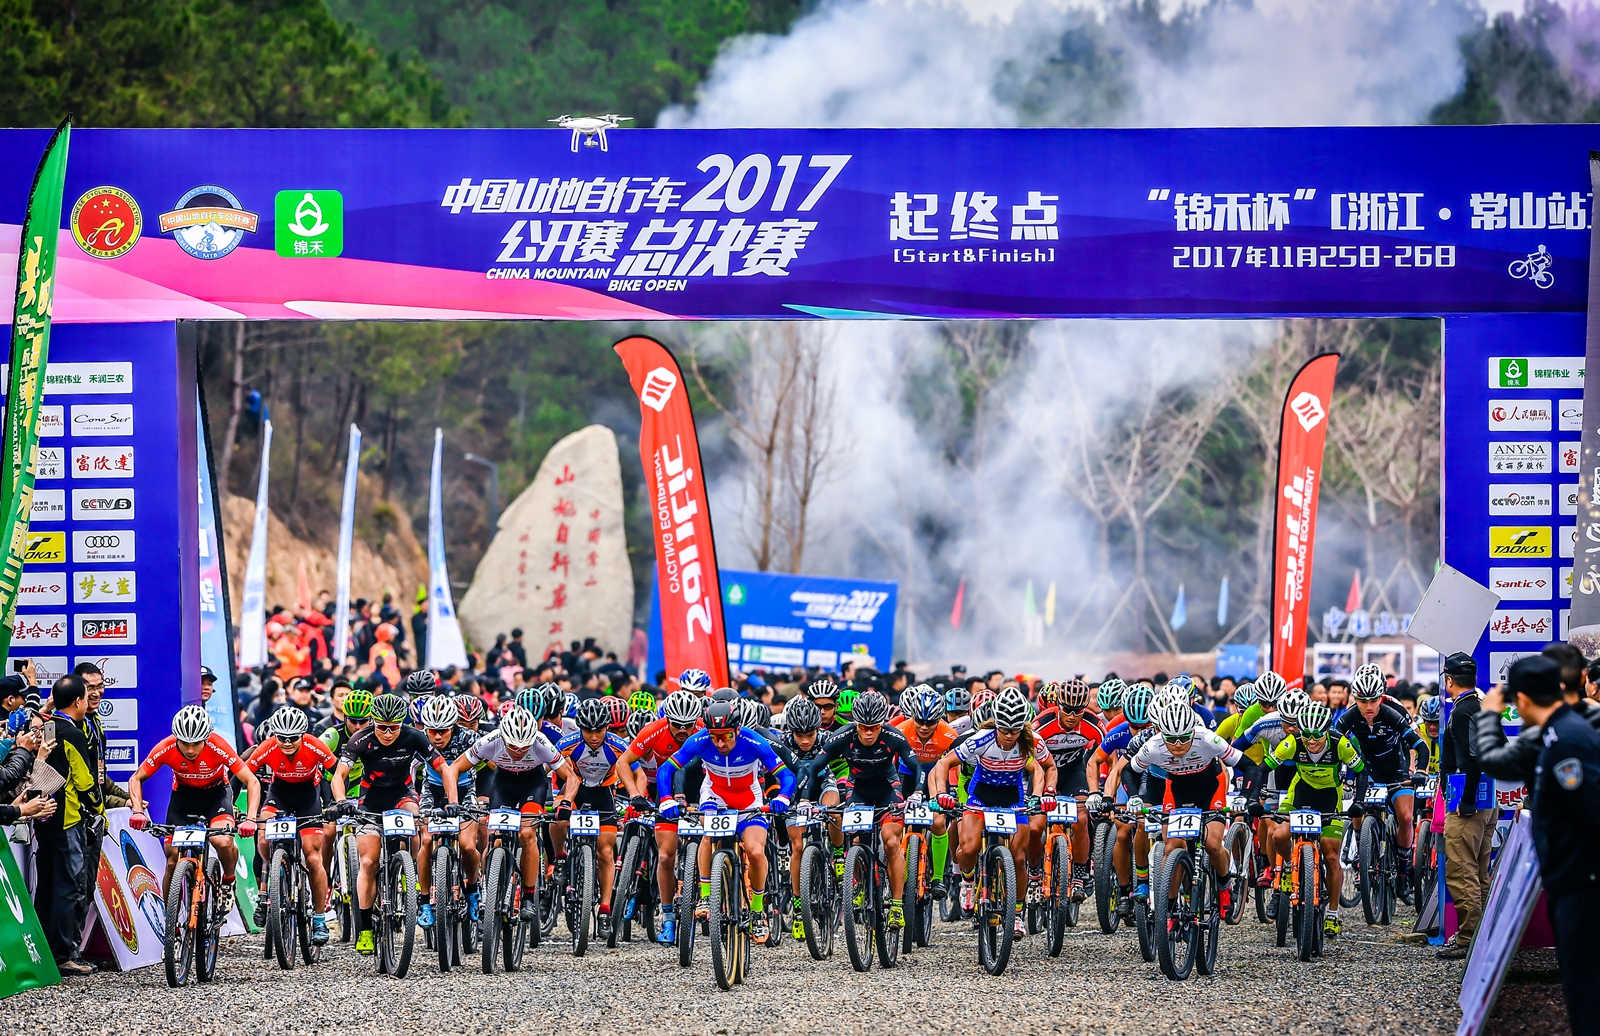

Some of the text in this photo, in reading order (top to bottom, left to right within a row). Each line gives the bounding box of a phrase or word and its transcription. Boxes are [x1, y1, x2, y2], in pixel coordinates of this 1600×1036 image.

[680, 153, 852, 213] 2017
[167, 211, 251, 226] 中国山地自行车公开赛
[889, 190, 1060, 241] 起终点
[293, 240, 325, 255] 锦禾
[495, 217, 819, 277] 公开赛 总决赛
[486, 267, 611, 280] CHINA MOUNTAIN
[607, 279, 687, 292] BIKE OPEN
[46, 374, 125, 384] 锦程伟业 禾润三农
[1534, 369, 1570, 379] 锦程伟业
[104, 412, 131, 424] Sur
[1494, 444, 1546, 455] ANYSA
[1294, 467, 1316, 602] CYCLING EQUIPMENT
[1494, 545, 1548, 554] TAOKAS
[79, 574, 131, 600] 梦之蓝
[1494, 579, 1534, 588] Santic
[1491, 615, 1549, 635] 娃哈哈
[394, 815, 404, 829] 6
[500, 813, 510, 825] 2
[576, 816, 594, 829] 15
[710, 816, 731, 831] 86
[853, 811, 862, 824] 3
[996, 813, 1005, 826] 5
[1175, 815, 1194, 830] 14
[1297, 813, 1315, 826] 18
[271, 822, 290, 834] 19
[184, 830, 195, 842] 7
